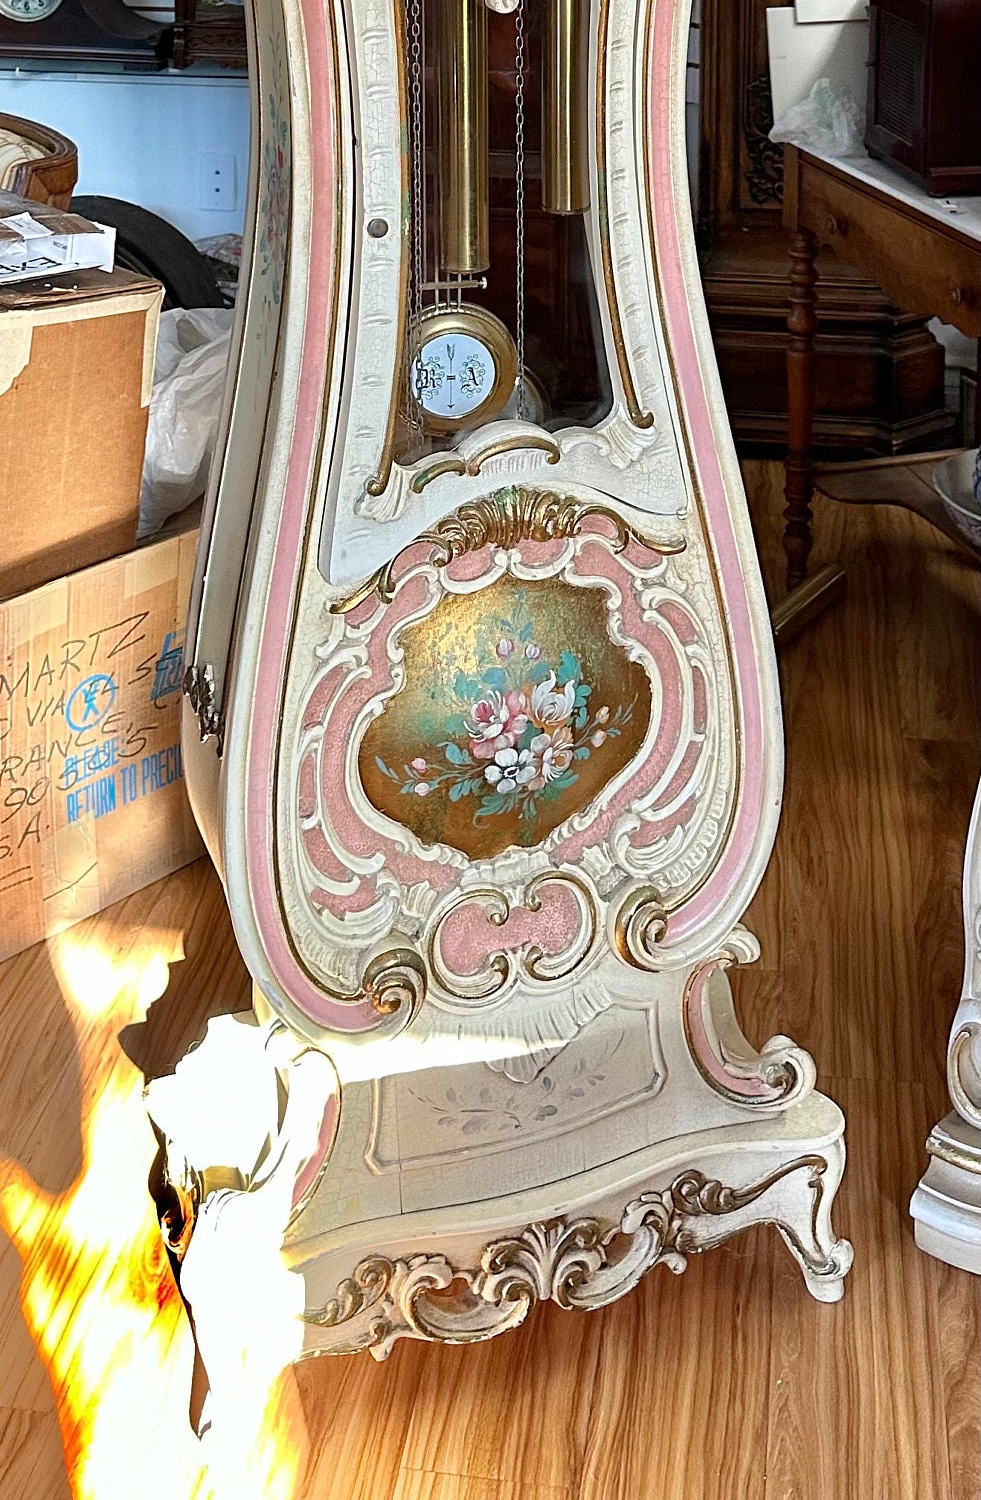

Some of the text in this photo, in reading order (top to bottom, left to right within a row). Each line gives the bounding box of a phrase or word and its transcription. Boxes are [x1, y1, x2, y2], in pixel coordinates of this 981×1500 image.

[27, 689, 66, 727] VIA
[66, 742, 184, 825] RETURN TO PRECI
